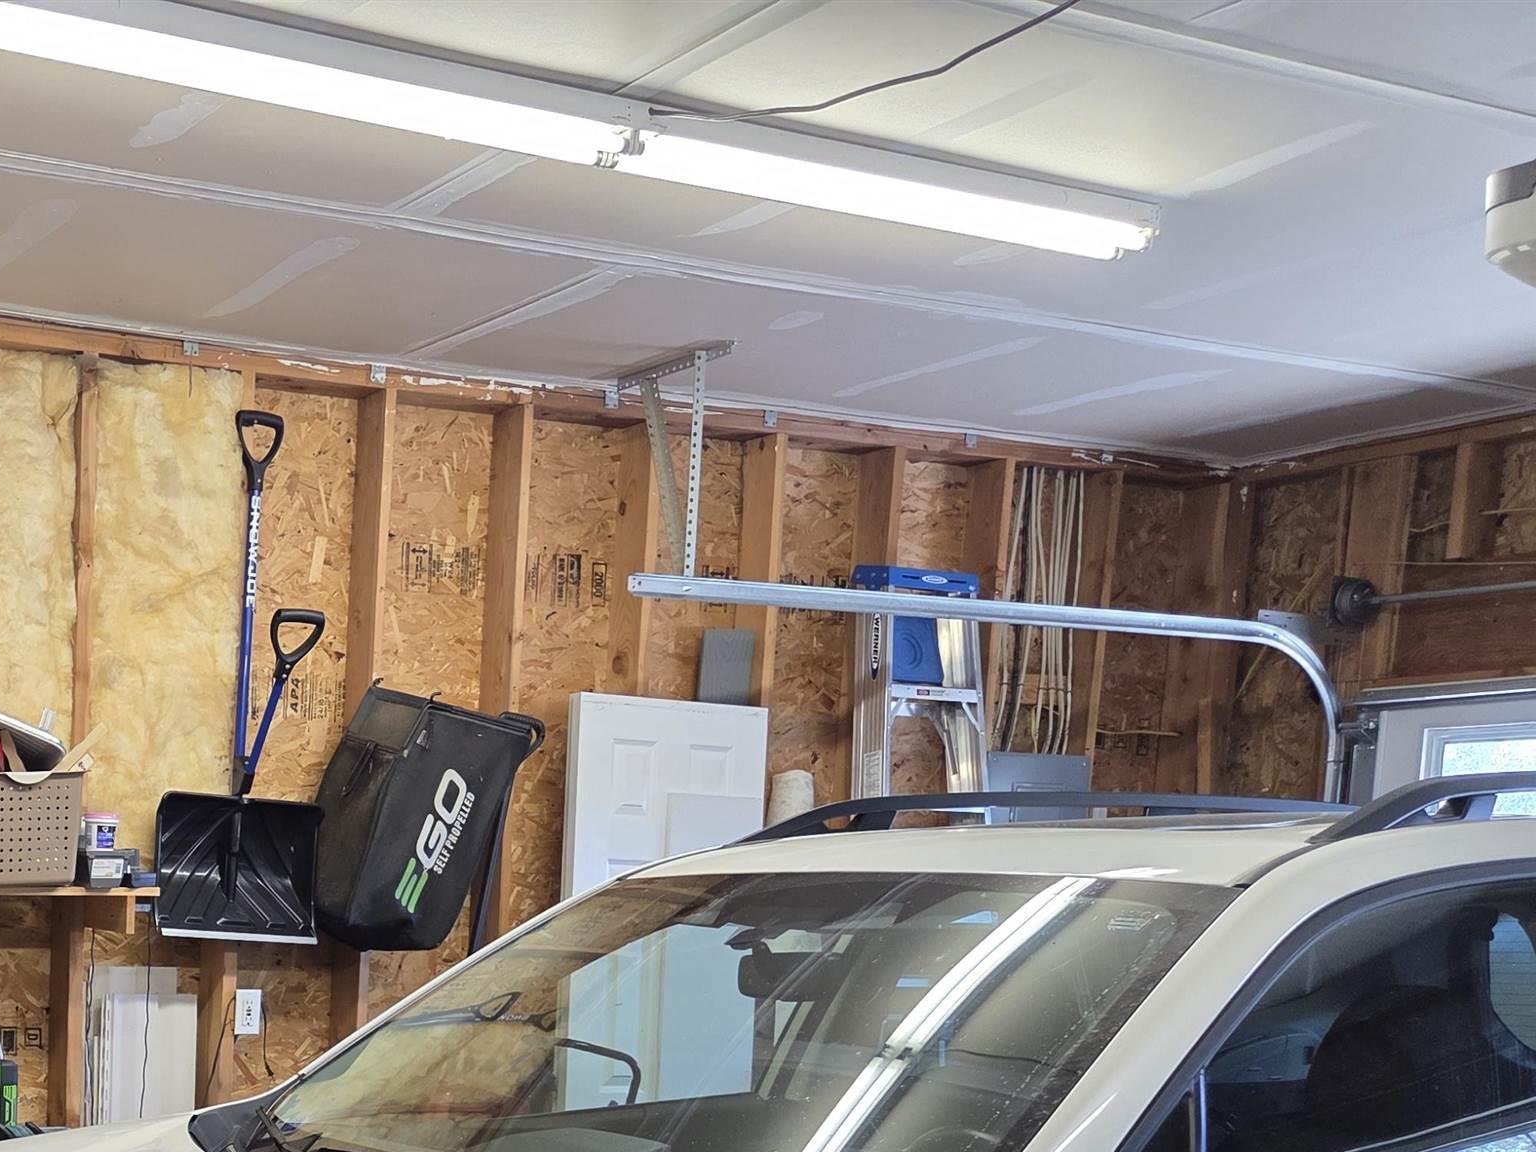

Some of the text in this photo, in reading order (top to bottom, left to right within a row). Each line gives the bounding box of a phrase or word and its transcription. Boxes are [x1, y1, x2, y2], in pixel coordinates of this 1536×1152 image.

[593, 571, 605, 598] 2000
[871, 617, 881, 663] WERNER
[290, 678, 300, 714] APA
[394, 768, 467, 914] EGO
[433, 791, 476, 875] SELF PROPELLED
